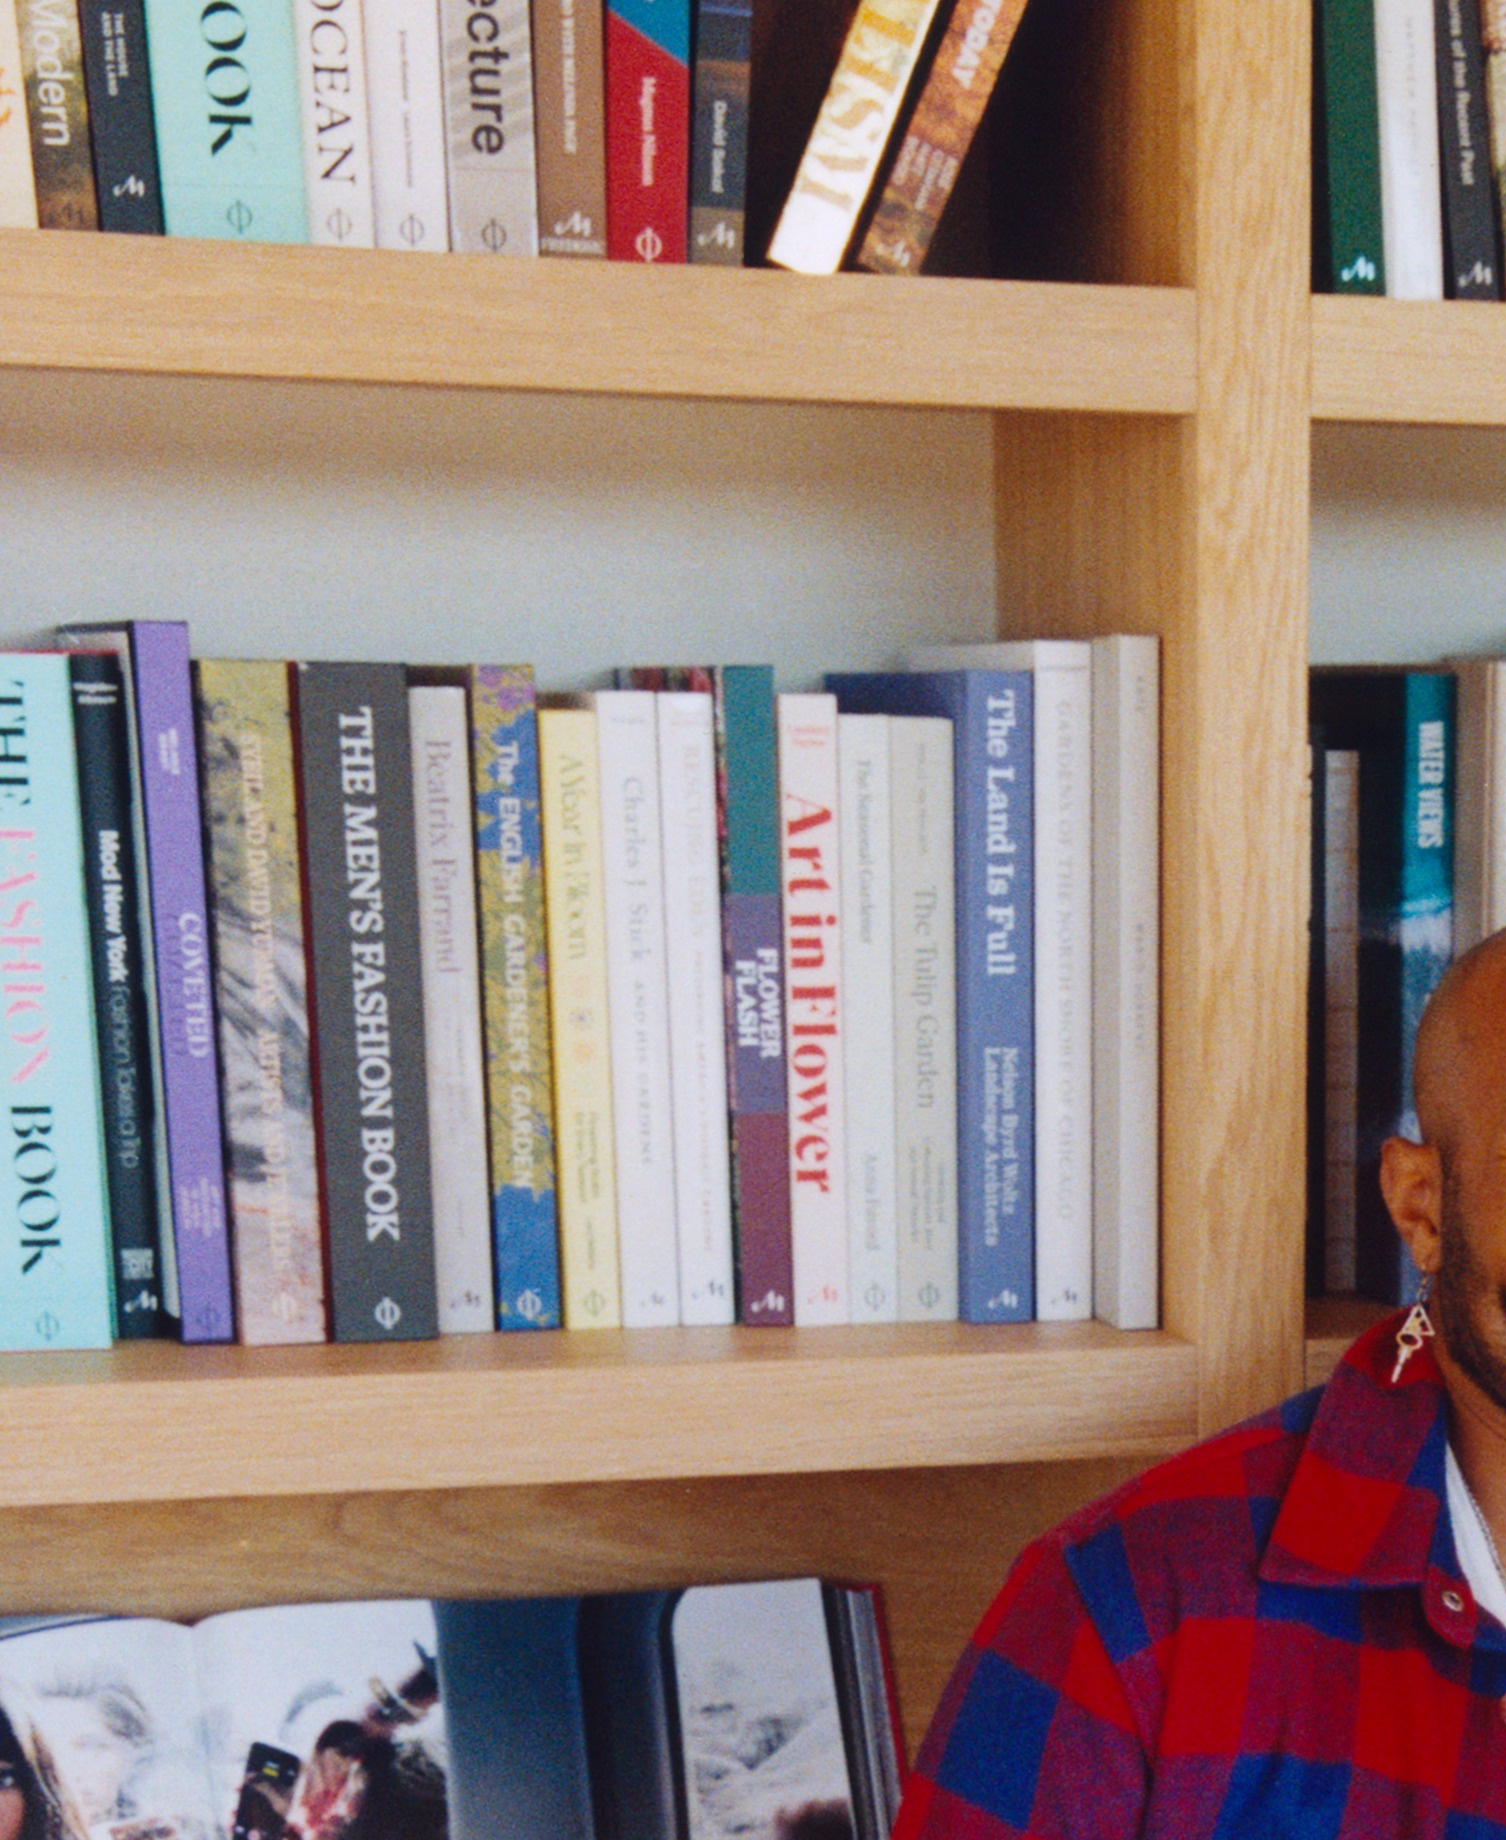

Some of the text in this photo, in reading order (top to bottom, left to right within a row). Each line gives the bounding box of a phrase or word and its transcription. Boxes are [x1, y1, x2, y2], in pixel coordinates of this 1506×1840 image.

[200, 0, 253, 157] OOK
[464, 0, 510, 156] cture
[495, 743, 519, 785] The
[559, 778, 585, 831] Year
[1419, 720, 1445, 850] WATER VIEWS
[98, 829, 122, 883] Mod
[423, 739, 464, 974] Beatrix Farrand
[497, 797, 526, 902] ENGLISH
[621, 777, 655, 871] Charles
[984, 690, 1015, 976] The Land Is Full
[102, 885, 125, 935] New
[245, 849, 273, 914] DAVID
[909, 885, 938, 934] The
[0, 682, 62, 1277] THE FASHION BOOK
[106, 937, 128, 982] York
[177, 911, 209, 1058] COVETED
[339, 706, 400, 1242] THE MEN'S FASHION BOOK
[735, 960, 760, 1048] FLASH
[756, 948, 781, 1060] FLOWER
[784, 793, 839, 1196] Art in Flower
[911, 945, 943, 1007] Tulip
[912, 1015, 942, 1109] Garden
[999, 1047, 1018, 1110] Nelson
[509, 1085, 535, 1189] GARDEN
[979, 1046, 1003, 1246] Landscape Architects
